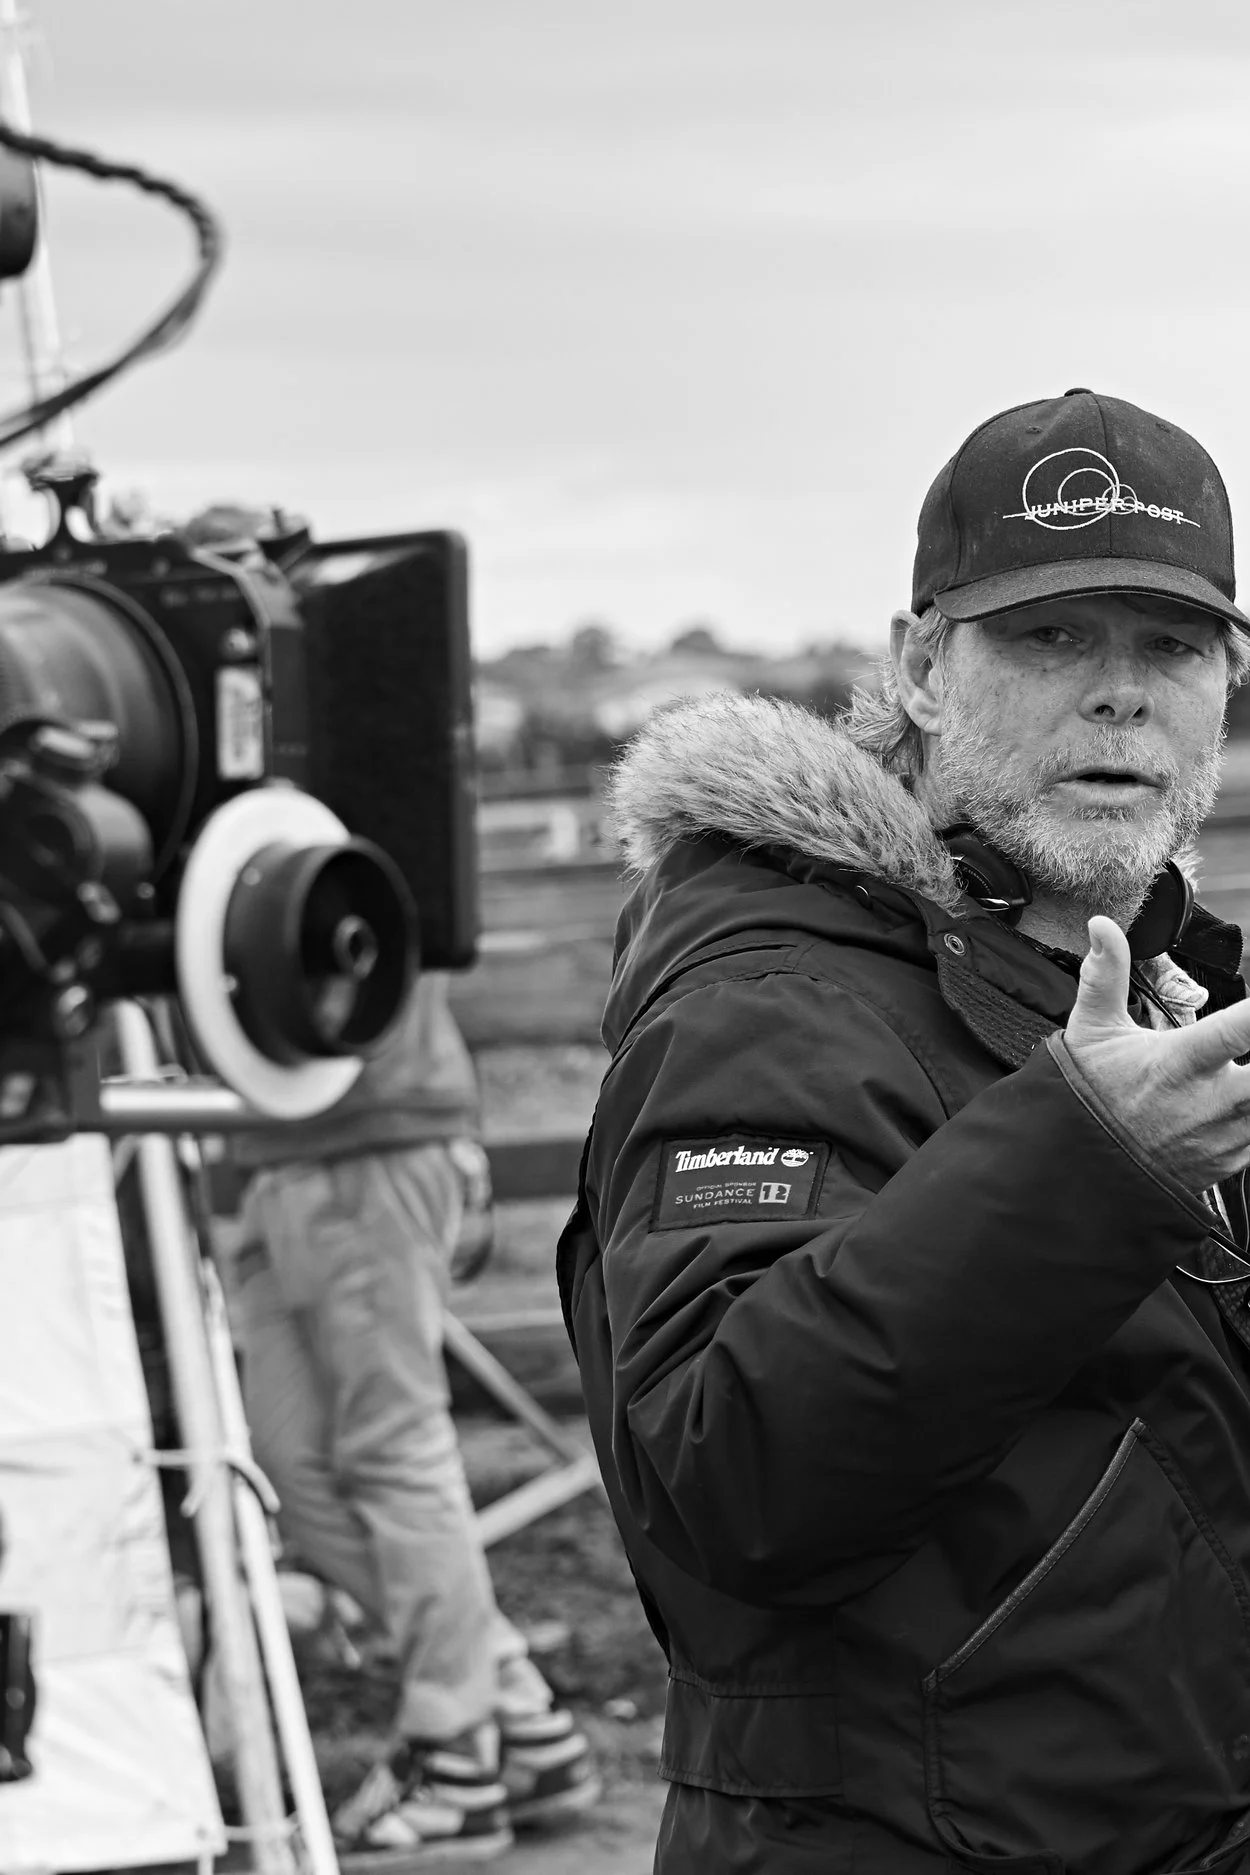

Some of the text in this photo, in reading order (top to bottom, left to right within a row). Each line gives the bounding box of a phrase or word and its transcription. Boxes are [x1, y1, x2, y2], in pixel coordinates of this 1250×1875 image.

[1025, 497, 1183, 524] JUNIPER POST
[675, 1145, 780, 1172] Timberland
[675, 1188, 755, 1204] SUNDANCE
[762, 1184, 787, 1200] 12
[693, 1198, 753, 1209] FILM FESTIVAL
